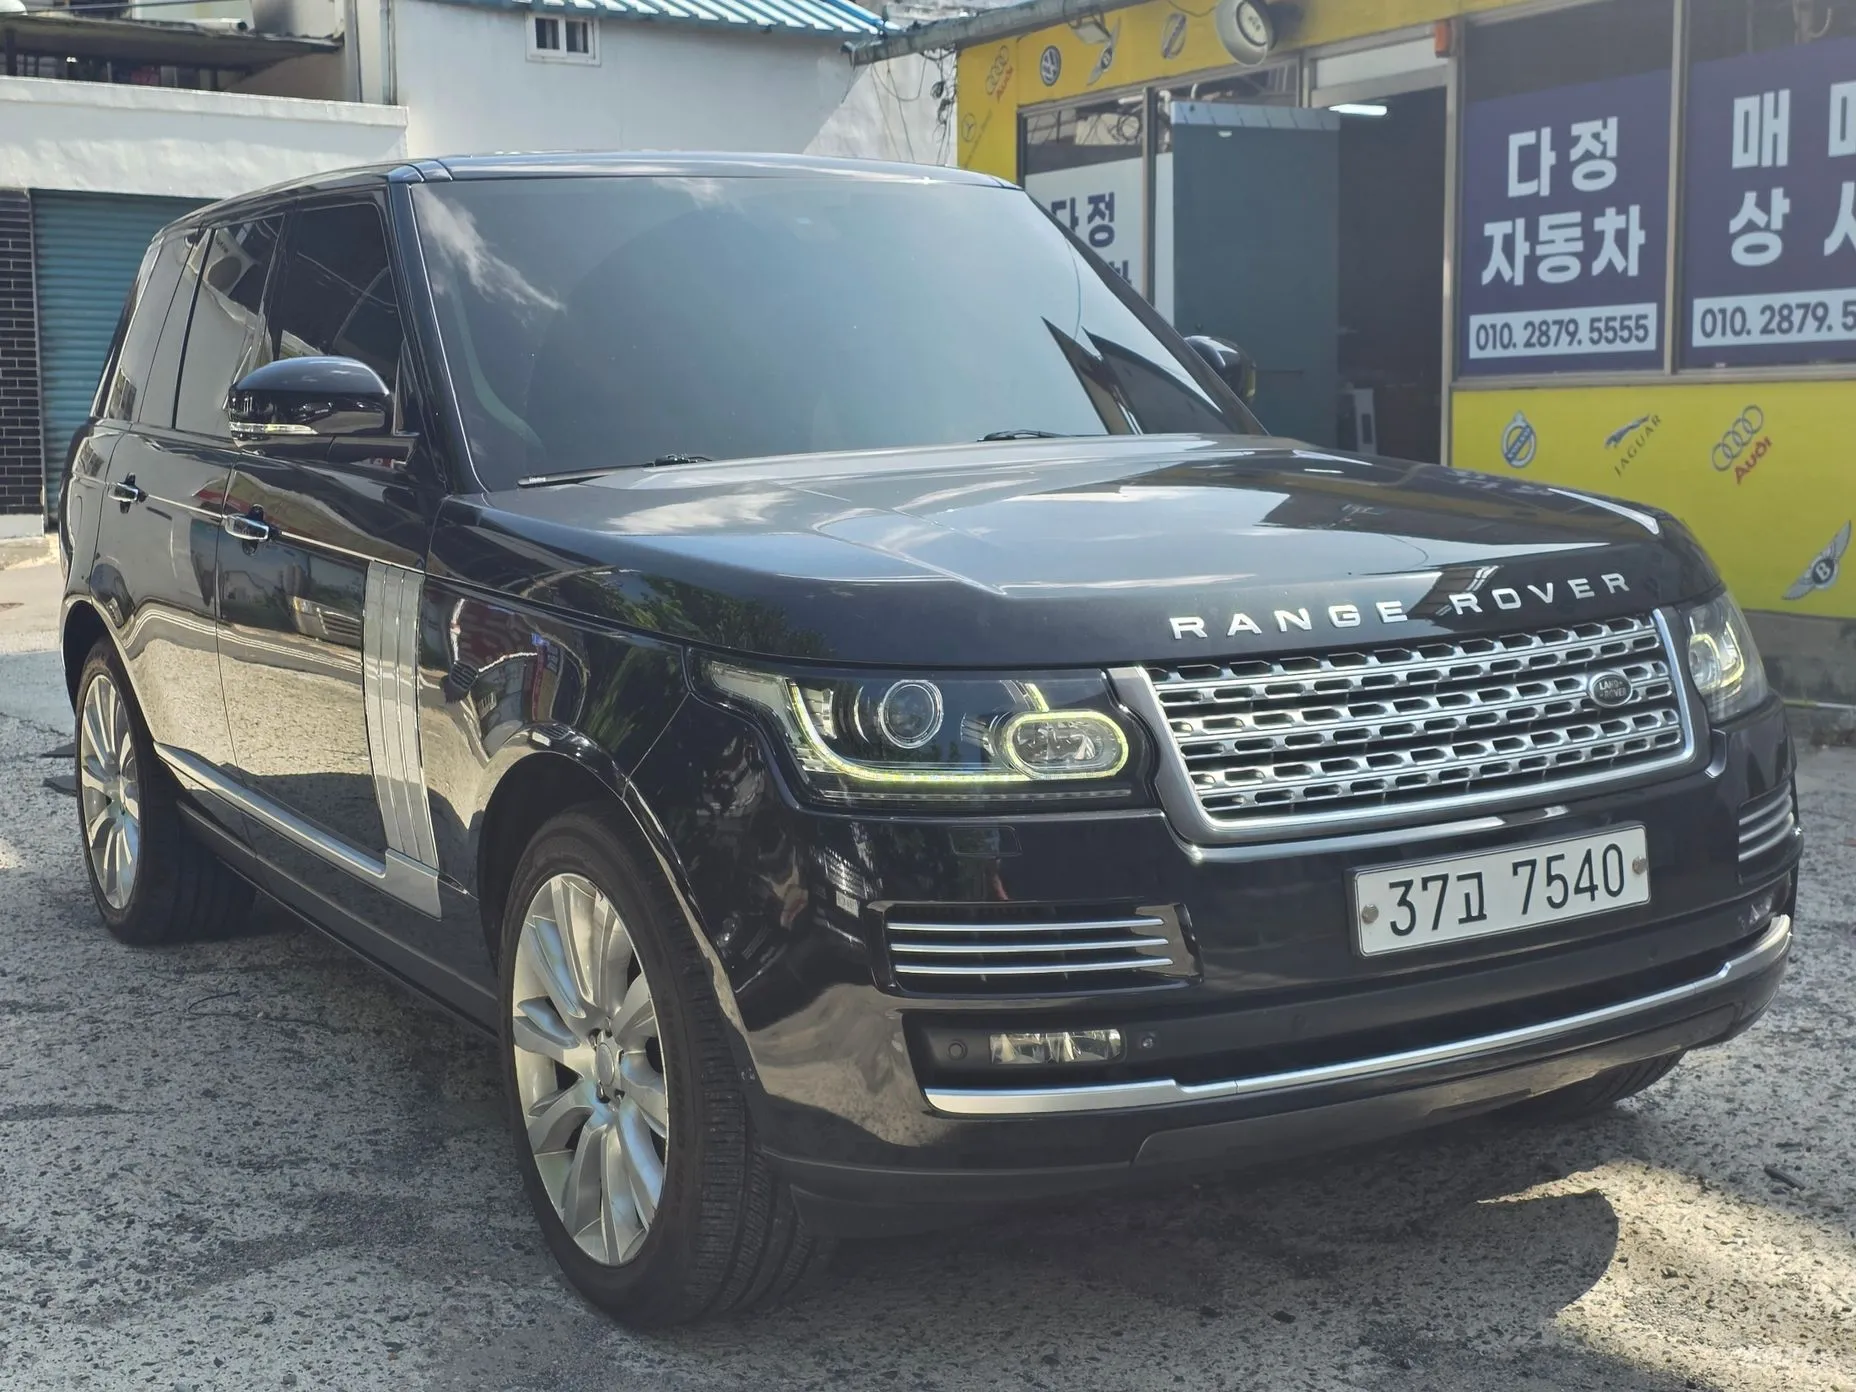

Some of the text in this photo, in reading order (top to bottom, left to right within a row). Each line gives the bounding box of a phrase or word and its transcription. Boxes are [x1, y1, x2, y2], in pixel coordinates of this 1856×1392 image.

[1508, 116, 1618, 197] 다정
[1482, 204, 1646, 286] 자동차
[1614, 414, 1662, 478] JAGUAR
[1169, 573, 1631, 640] RANGE ROVER
[1388, 843, 1625, 937] 37고 7540
